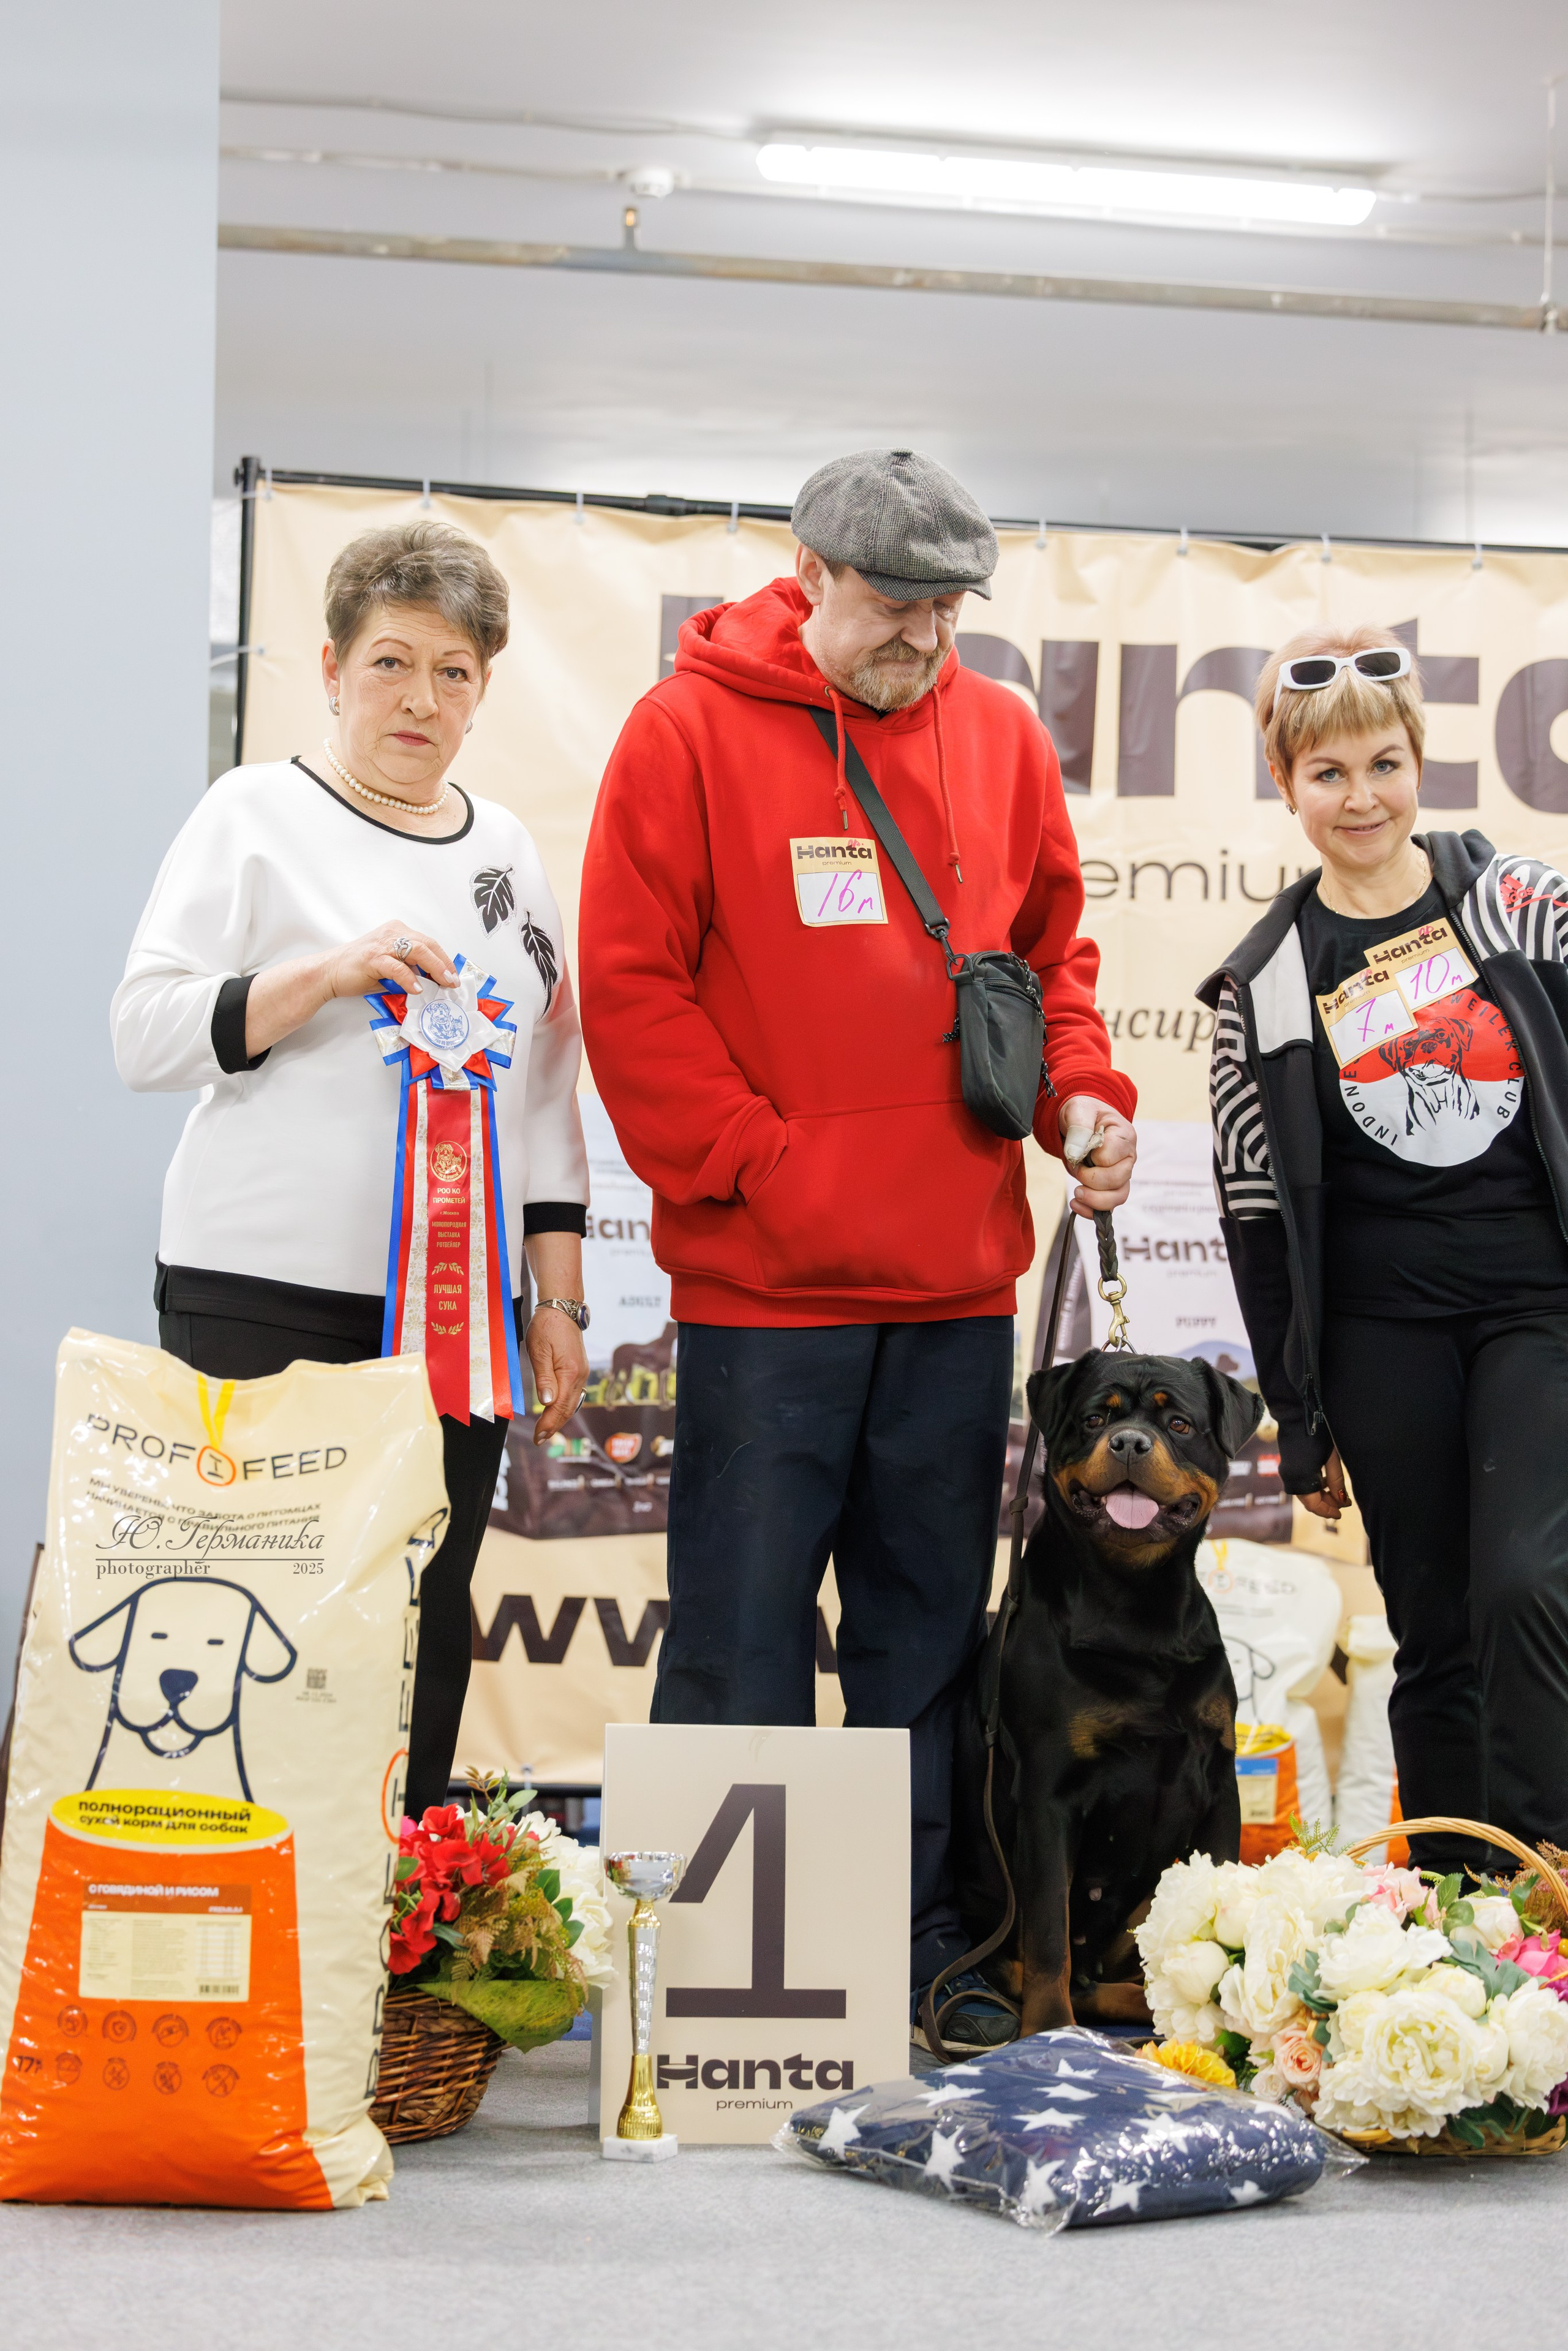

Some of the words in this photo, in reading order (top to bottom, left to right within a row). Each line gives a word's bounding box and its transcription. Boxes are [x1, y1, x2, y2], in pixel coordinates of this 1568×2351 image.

[797, 845, 872, 859] Hanta
[1373, 927, 1448, 964] Hanta
[1401, 948, 1430, 964] premium
[1322, 970, 1390, 1014] Hanta
[1497, 1061, 1521, 1119] CLUB
[1121, 1236, 1227, 1262] Hant
[434, 1284, 462, 1294] ЛУЧШАЯ
[439, 1300, 457, 1310] СУКА
[79, 1801, 251, 1821] полнорационный
[123, 1817, 162, 1828] корм
[165, 1820, 195, 1830] для
[666, 1784, 846, 2019] 1
[657, 2053, 854, 2090] Hanta
[717, 2097, 793, 2111] premium
